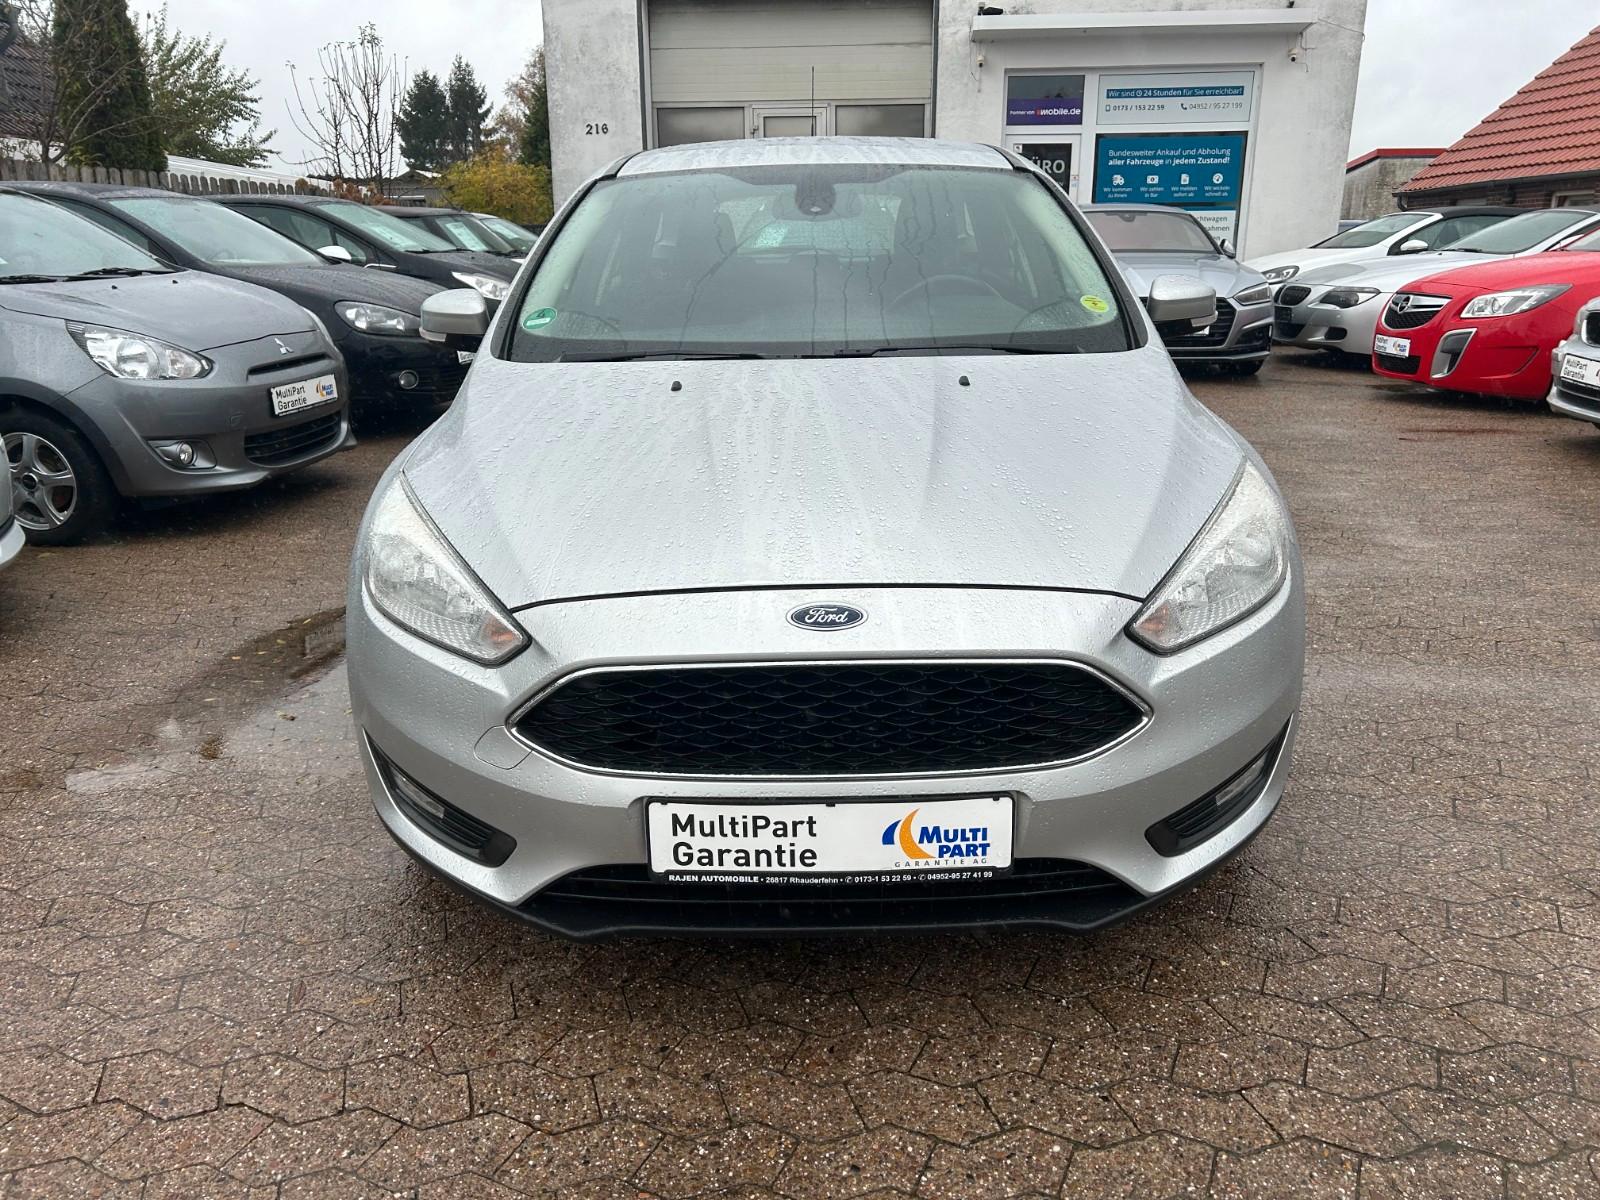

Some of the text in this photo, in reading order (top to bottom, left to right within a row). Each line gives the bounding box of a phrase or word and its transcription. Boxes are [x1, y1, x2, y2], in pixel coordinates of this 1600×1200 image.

[1205, 87, 1242, 95] erreichbar!
[585, 123, 608, 134] 216
[1108, 149, 1155, 157] Bundesweiter
[1156, 148, 1180, 156] Ankauf
[1197, 148, 1231, 156] Abholung
[1032, 156, 1065, 174] ÜRO
[1108, 158, 1124, 166] aller
[1127, 158, 1164, 167] Fahrzeuge
[1172, 157, 1196, 166] jedem
[276, 386, 306, 399] MultiPart
[278, 396, 307, 410] Garantie
[805, 607, 848, 623] Ford
[672, 813, 816, 837] MultiPart
[918, 826, 987, 844] MULTI
[672, 842, 817, 867] Garantie
[938, 844, 990, 858] PART
[894, 859, 965, 868] GARANTIE
[669, 874, 698, 882] RAJEN
